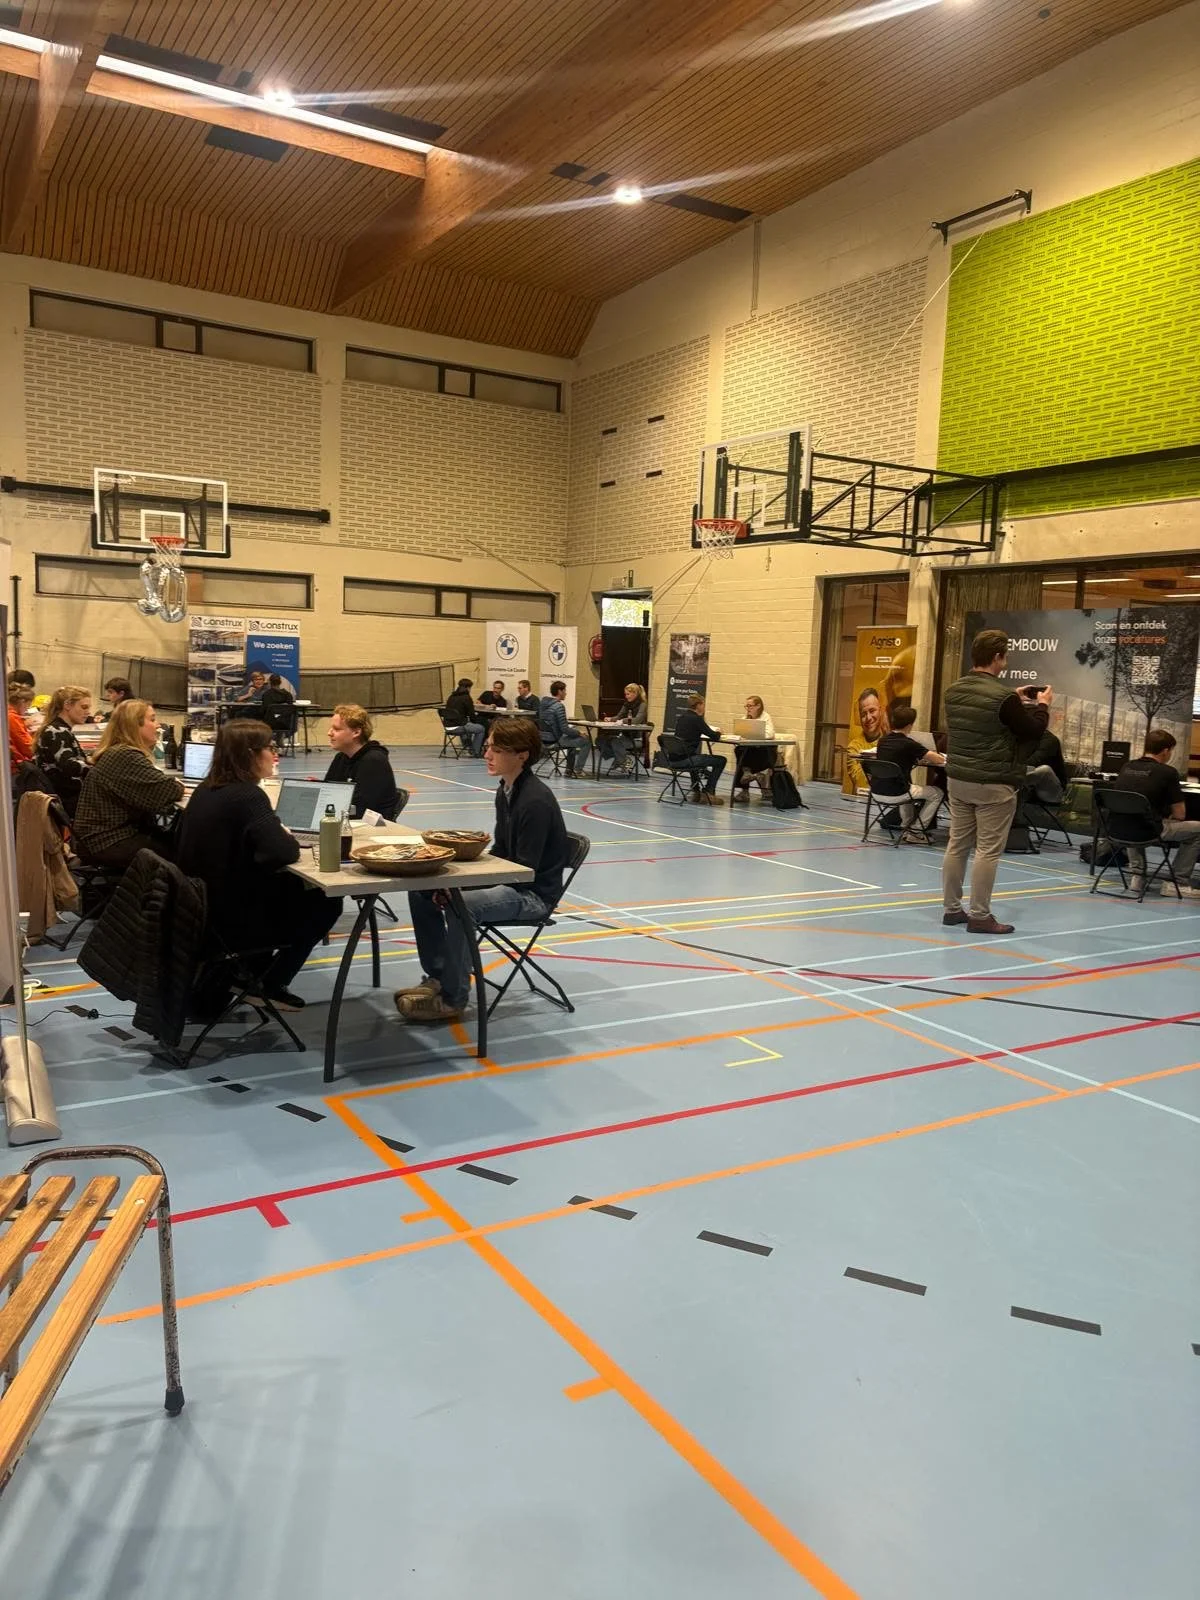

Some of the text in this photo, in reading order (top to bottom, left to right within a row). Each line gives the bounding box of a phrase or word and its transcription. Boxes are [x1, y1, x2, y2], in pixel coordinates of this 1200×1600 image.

[1095, 621, 1117, 630] Scan
[1134, 620, 1167, 630] ontdek
[871, 635, 901, 649] Agristo
[1095, 636, 1117, 644] onze
[253, 641, 294, 650] We zoeken
[1010, 670, 1038, 680] mee
